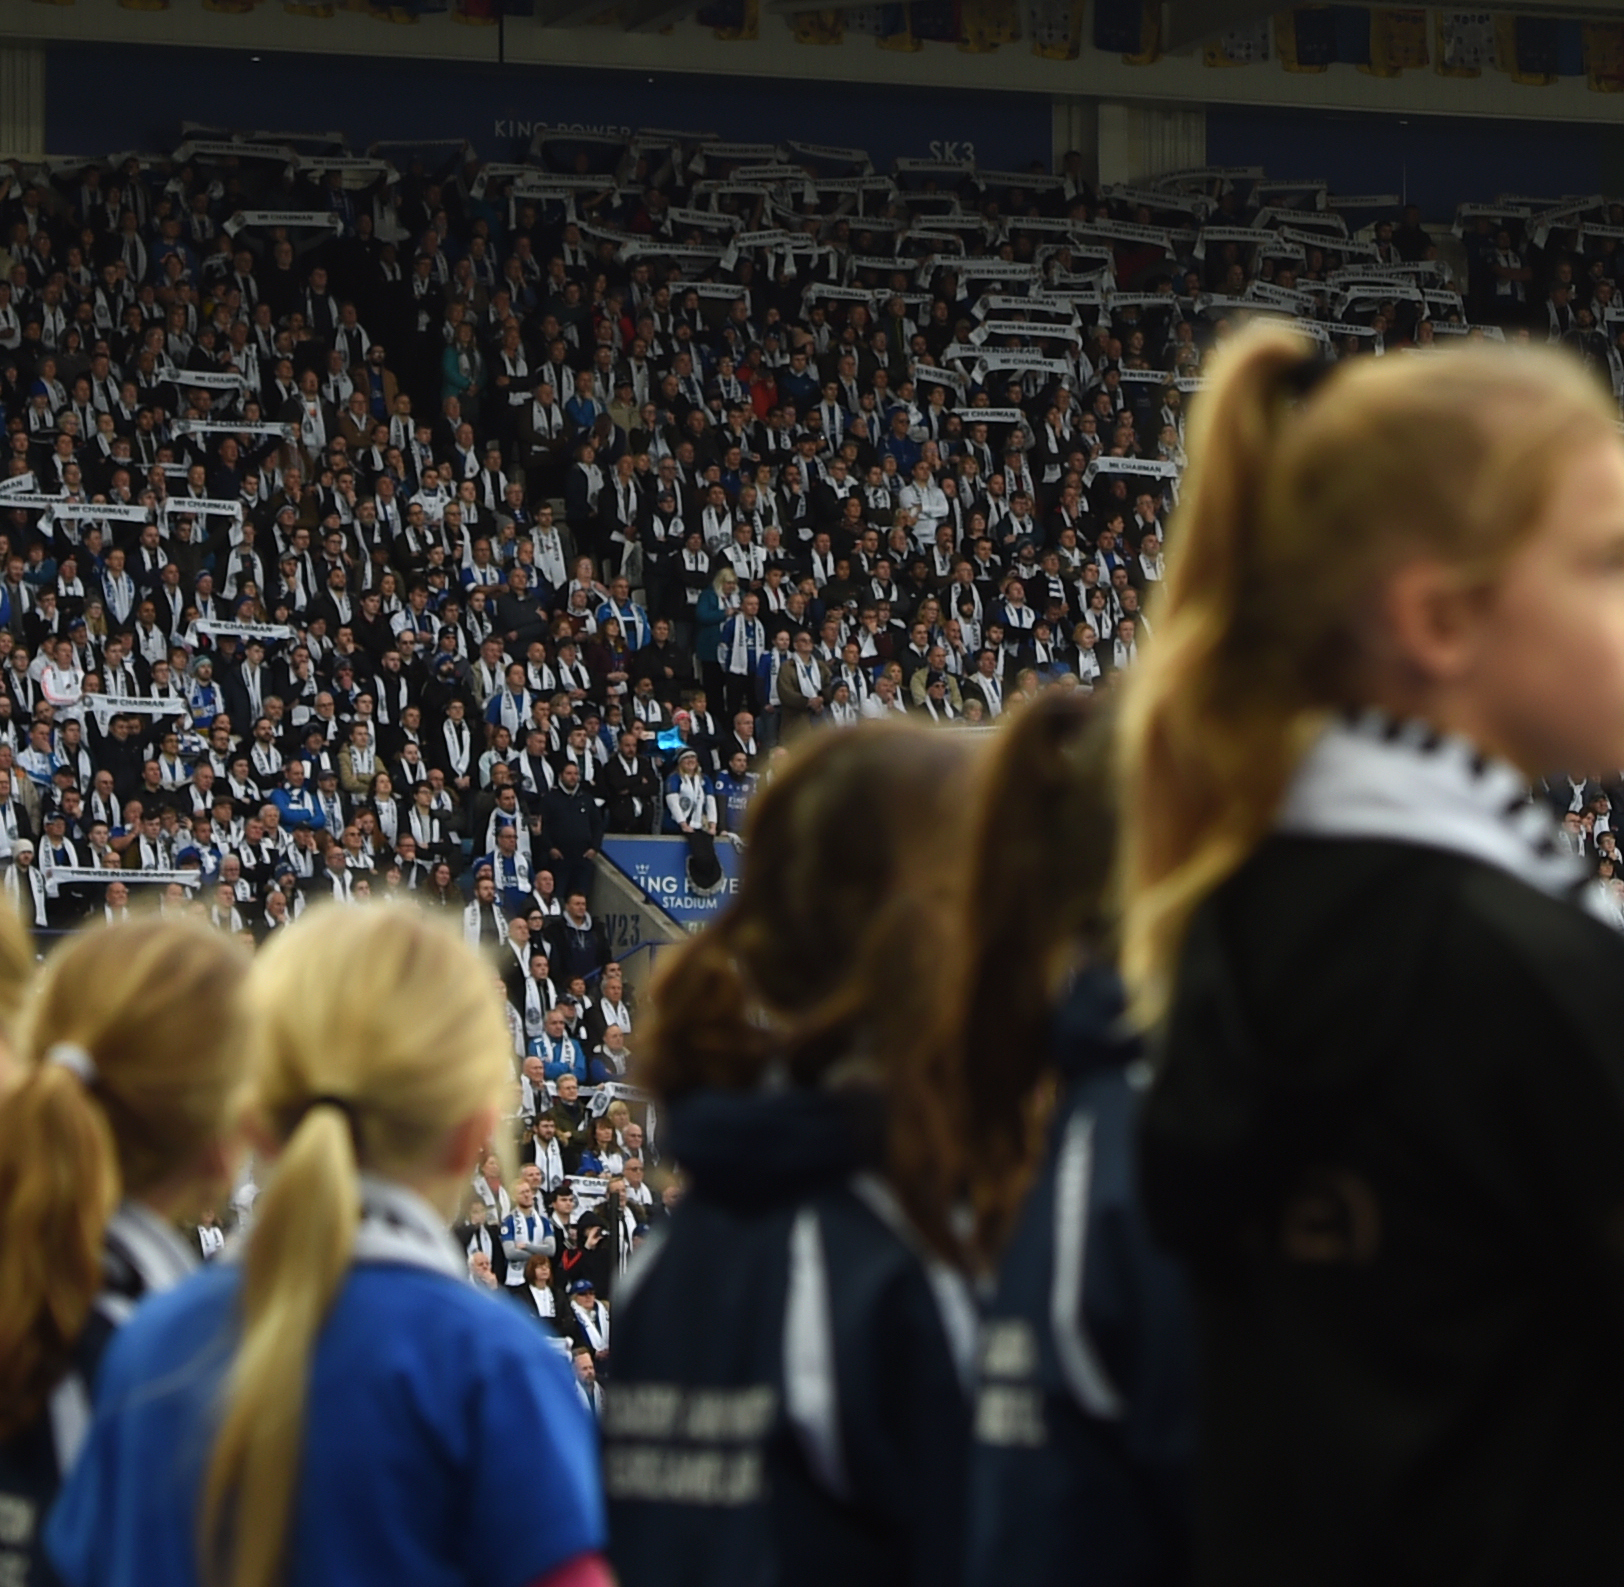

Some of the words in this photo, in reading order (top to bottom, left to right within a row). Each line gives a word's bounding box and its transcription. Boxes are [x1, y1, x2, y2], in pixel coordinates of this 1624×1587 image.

[928, 140, 976, 165] SK3
[223, 623, 273, 633] CHAIRMAN
[662, 895, 718, 911] STADIUM
